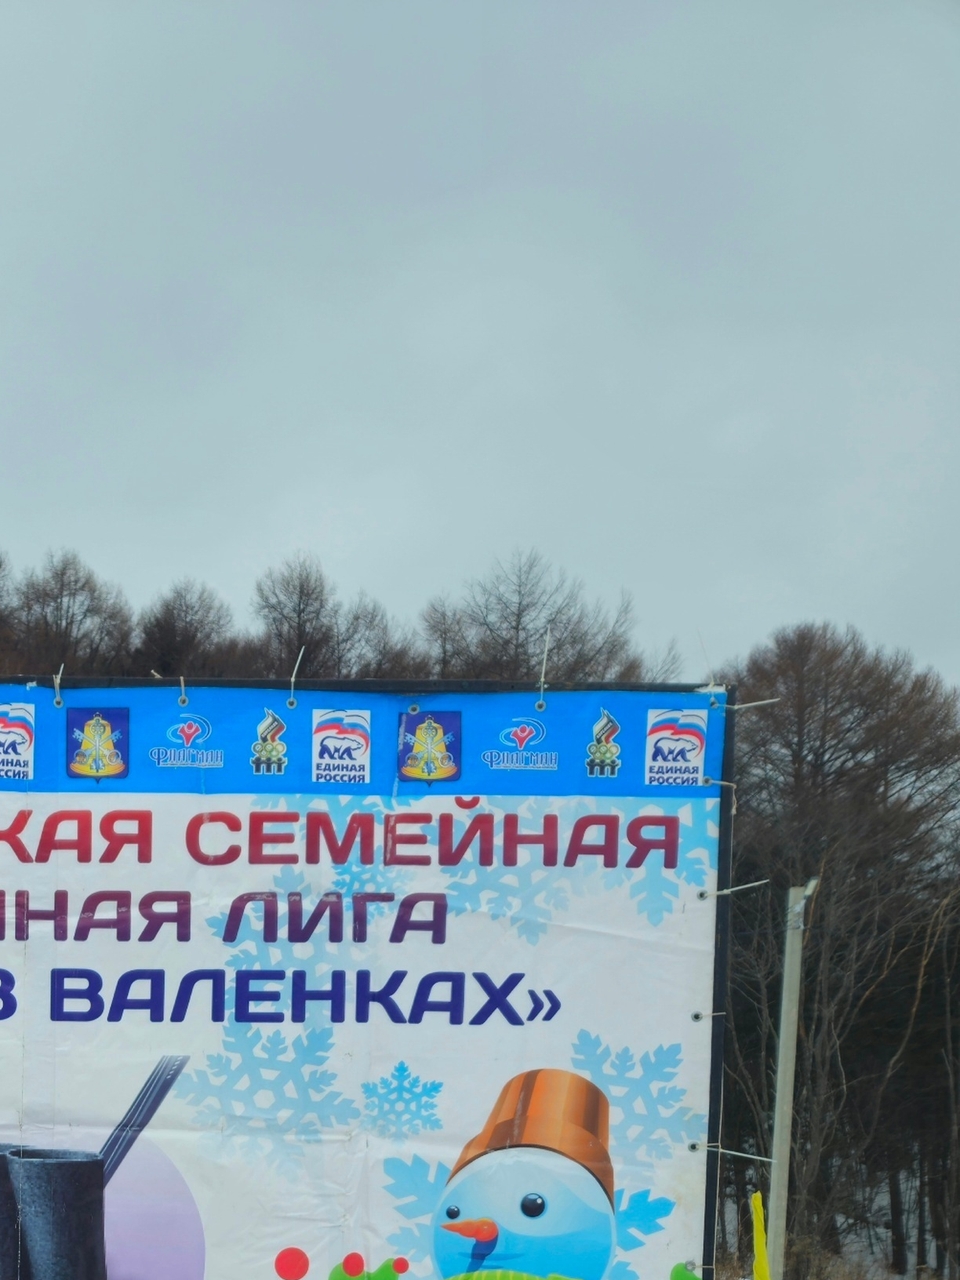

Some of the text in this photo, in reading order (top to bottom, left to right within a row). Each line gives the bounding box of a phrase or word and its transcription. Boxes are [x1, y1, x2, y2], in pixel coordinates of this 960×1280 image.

[316, 763, 365, 772] ЕДИНАЯ
[649, 766, 699, 774] ЕДИНАЯ
[316, 773, 365, 783] РОССИЯ
[649, 776, 699, 785] РОССИЯ
[185, 796, 680, 869] СЕМЕЙНАЯ
[222, 891, 448, 945] ЛИГА
[50, 968, 562, 1026] ВАЛЕНКАХ»
